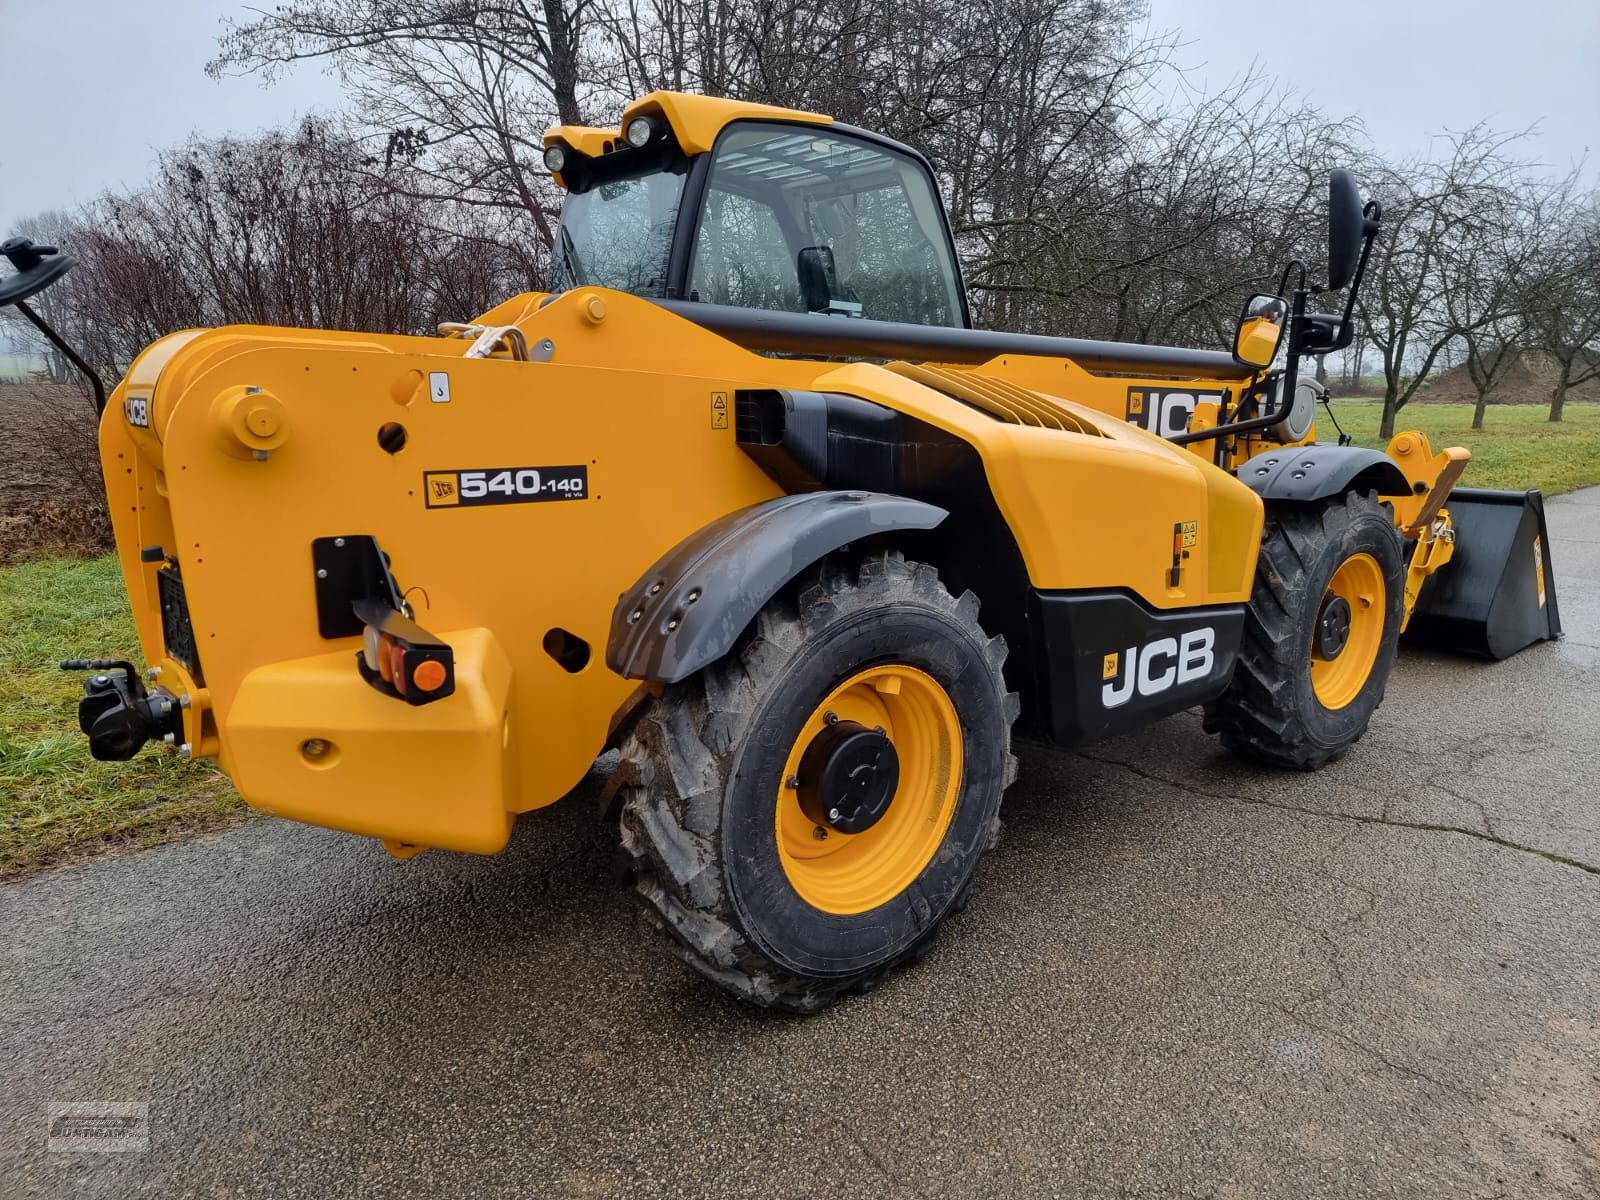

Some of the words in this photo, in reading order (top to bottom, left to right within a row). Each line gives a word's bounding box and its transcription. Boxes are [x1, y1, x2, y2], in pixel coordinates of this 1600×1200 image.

[129, 399, 148, 426] JCB
[1129, 393, 1223, 439] JC
[1102, 627, 1215, 709] JCB
